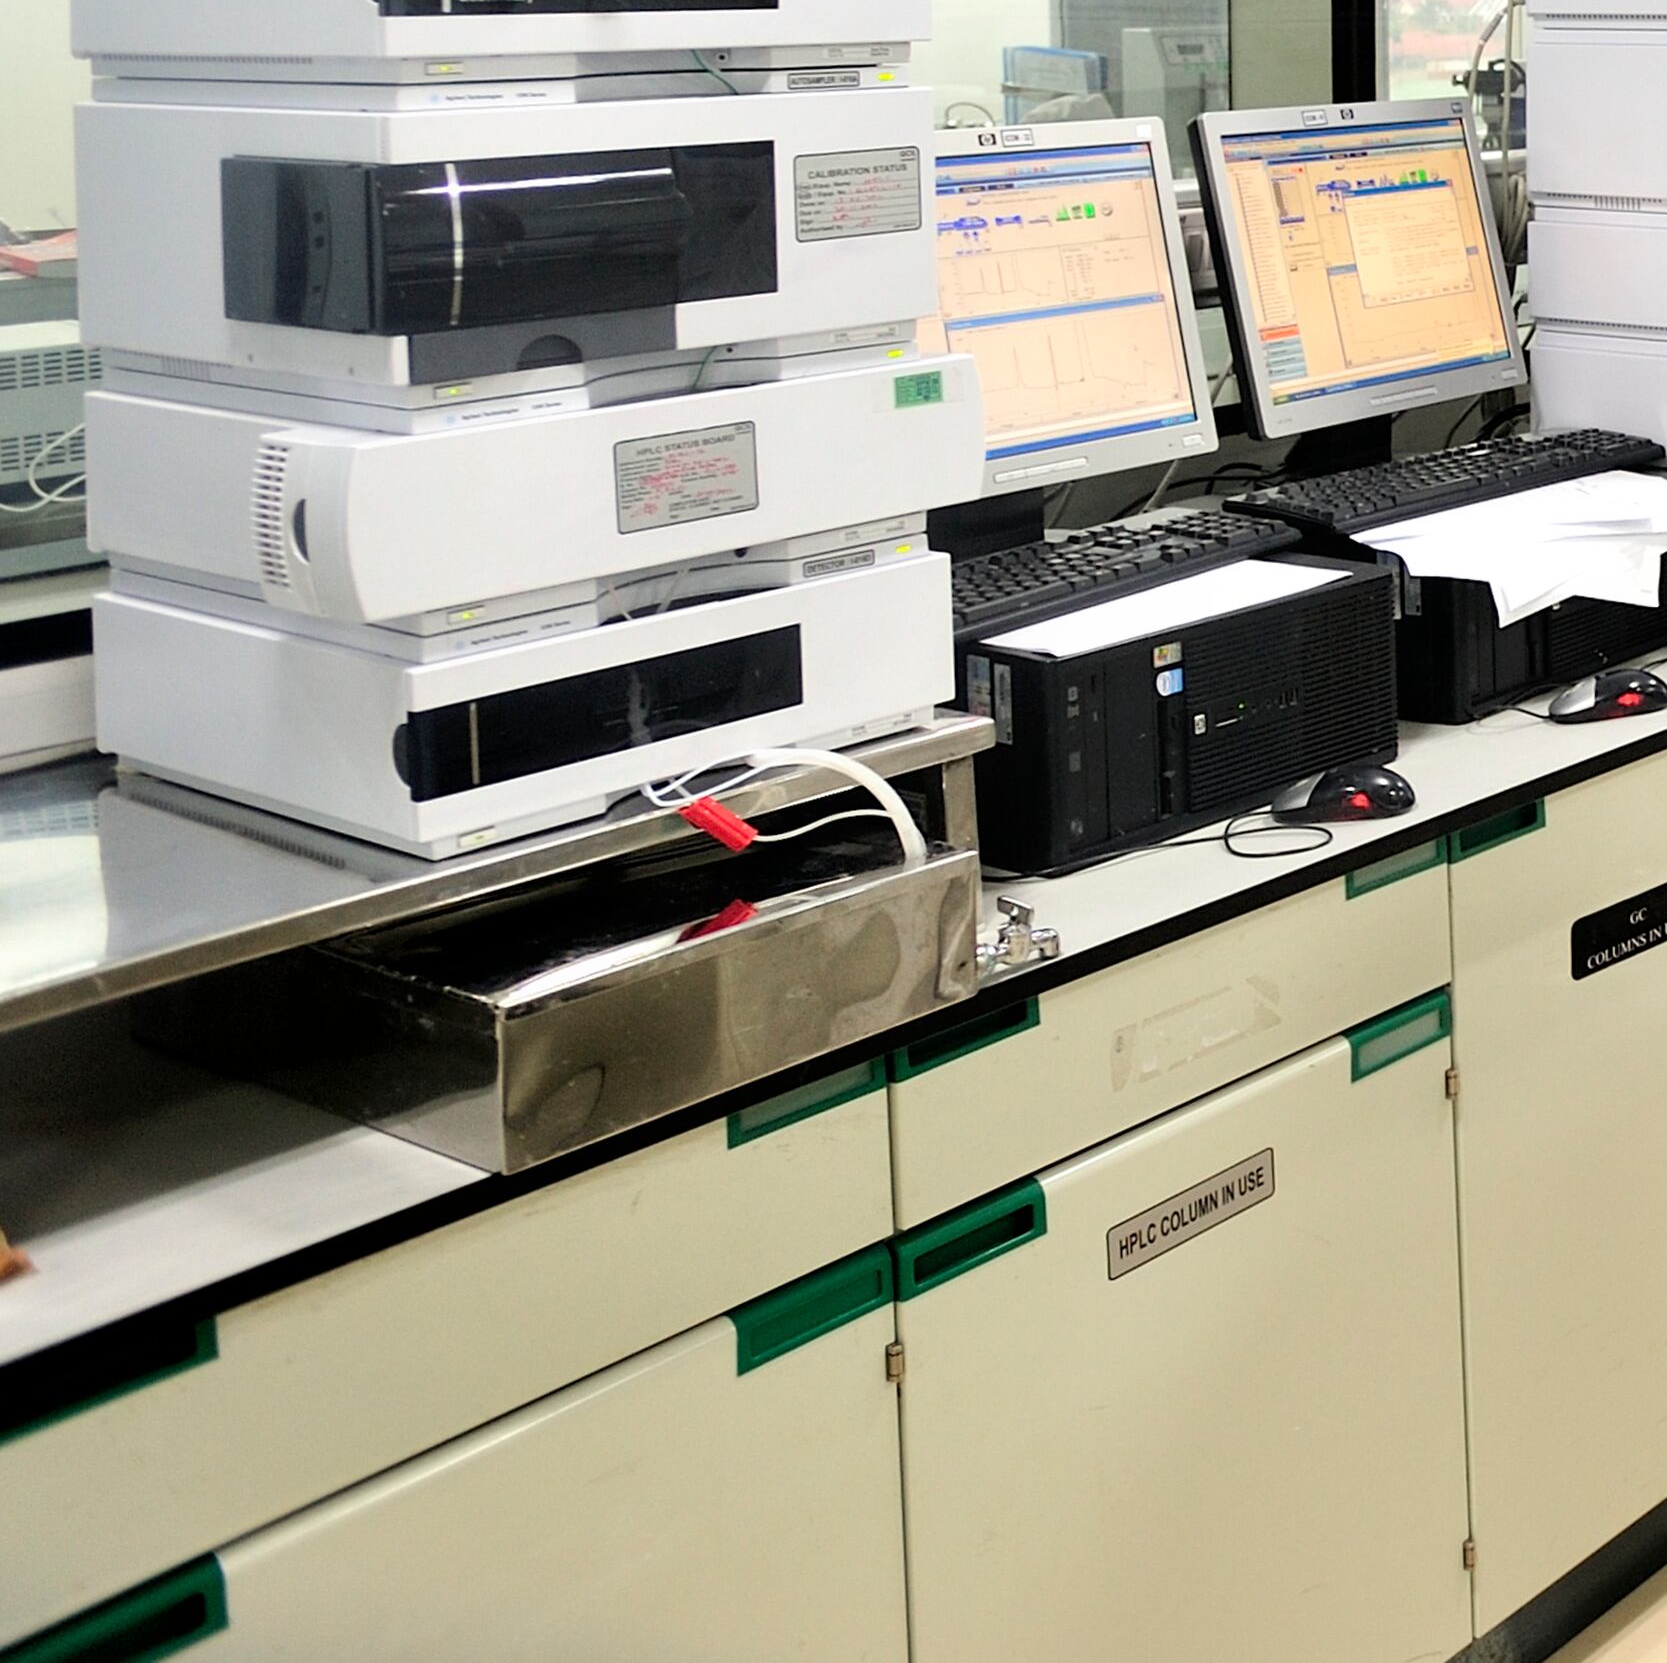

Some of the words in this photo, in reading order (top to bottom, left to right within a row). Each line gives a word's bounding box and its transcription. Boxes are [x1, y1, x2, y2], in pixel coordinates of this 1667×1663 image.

[808, 166, 870, 179] CALIBRATION
[873, 163, 908, 174] STATUS
[636, 445, 662, 456] HPLC
[664, 440, 700, 452] STATUS
[701, 434, 736, 446] BOARD
[1629, 907, 1648, 925] GC
[1586, 932, 1647, 970] COLUMNS
[1648, 924, 1662, 944] IN
[1118, 1222, 1157, 1259] HPLC
[1160, 1189, 1219, 1237] COLUMN
[1221, 1181, 1235, 1206] IN
[1238, 1165, 1265, 1197] USE
